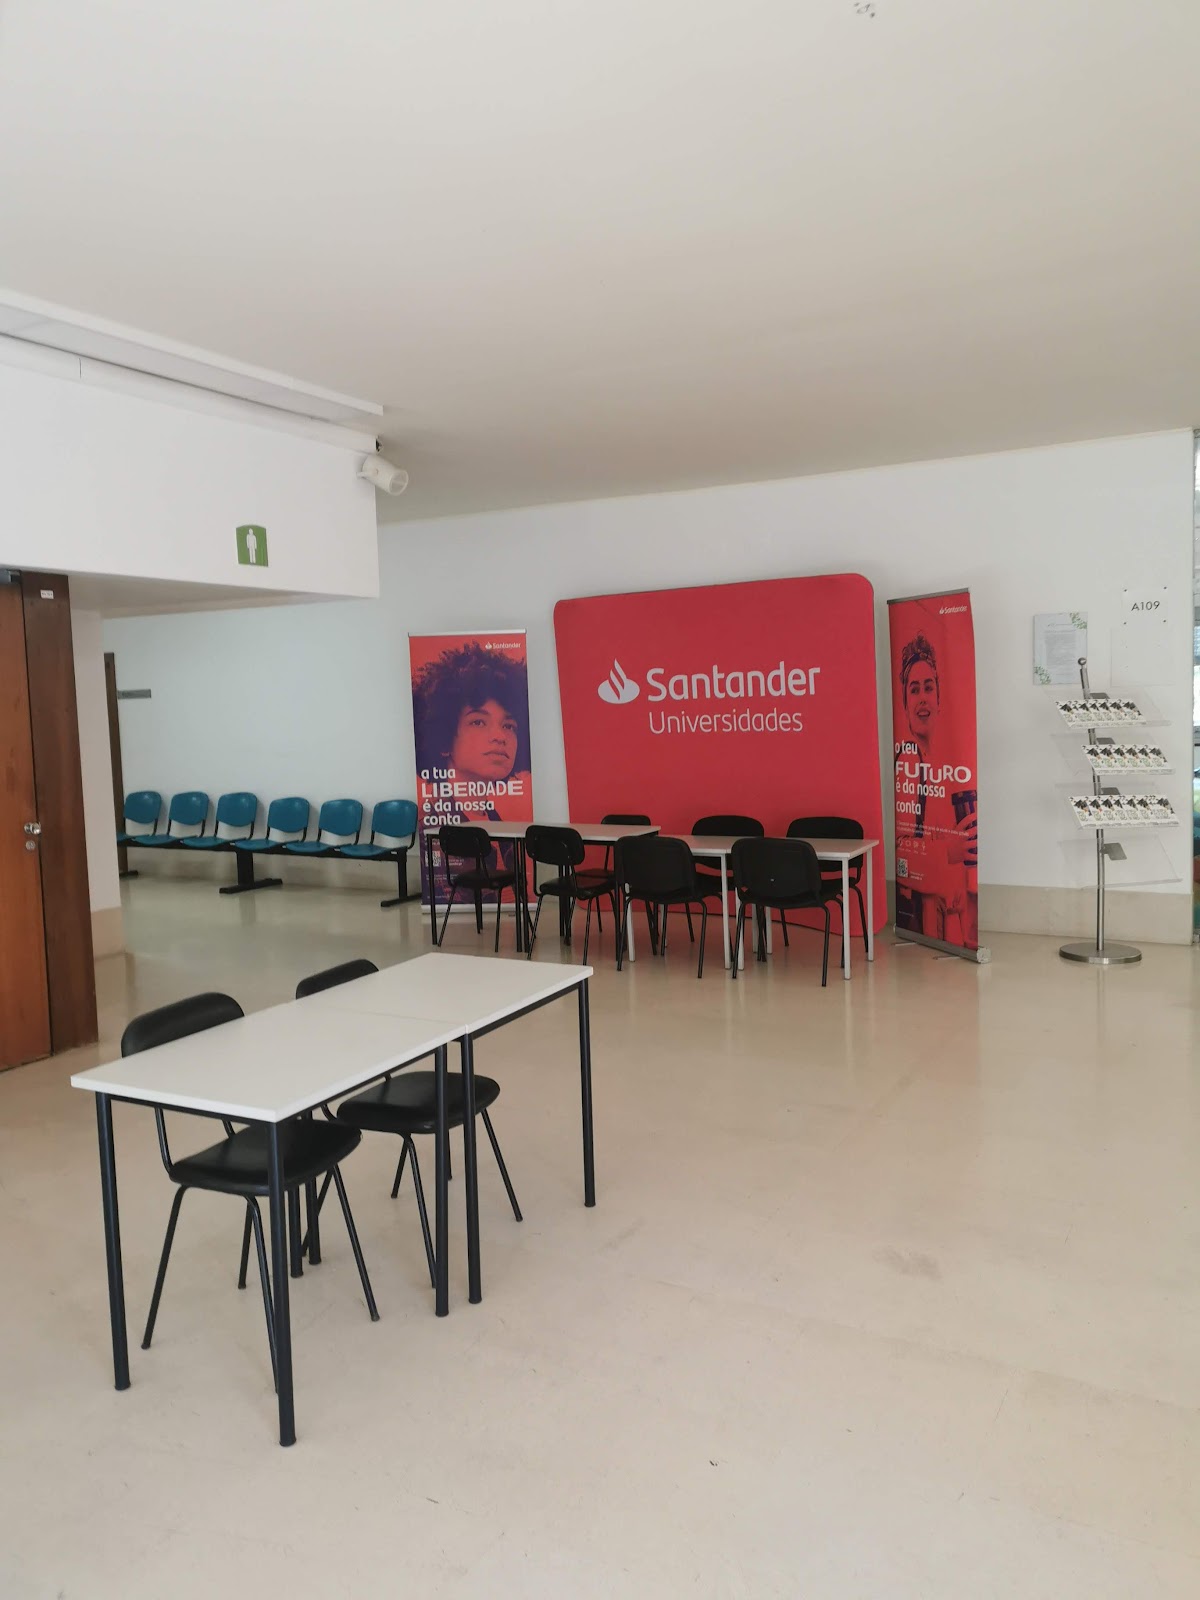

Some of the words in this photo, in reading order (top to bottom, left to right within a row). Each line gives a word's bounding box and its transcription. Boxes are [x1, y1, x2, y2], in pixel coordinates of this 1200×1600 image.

[945, 606, 968, 614] Santander
[1131, 600, 1160, 611] A109
[493, 642, 522, 650] Santander
[646, 661, 821, 702] Santander
[648, 707, 803, 735] Universidades
[895, 742, 901, 754] o
[901, 740, 918, 755] teu
[421, 769, 430, 779] a
[433, 767, 456, 779] tua
[895, 761, 972, 784] FUTURO
[422, 780, 524, 798] LIBERDADE
[895, 777, 901, 793] é
[902, 778, 915, 794] da
[917, 783, 946, 798] nossa
[423, 799, 431, 812] é
[434, 799, 452, 812] da
[455, 800, 495, 811] nossa
[896, 800, 922, 815] conta
[423, 813, 461, 826] conta
